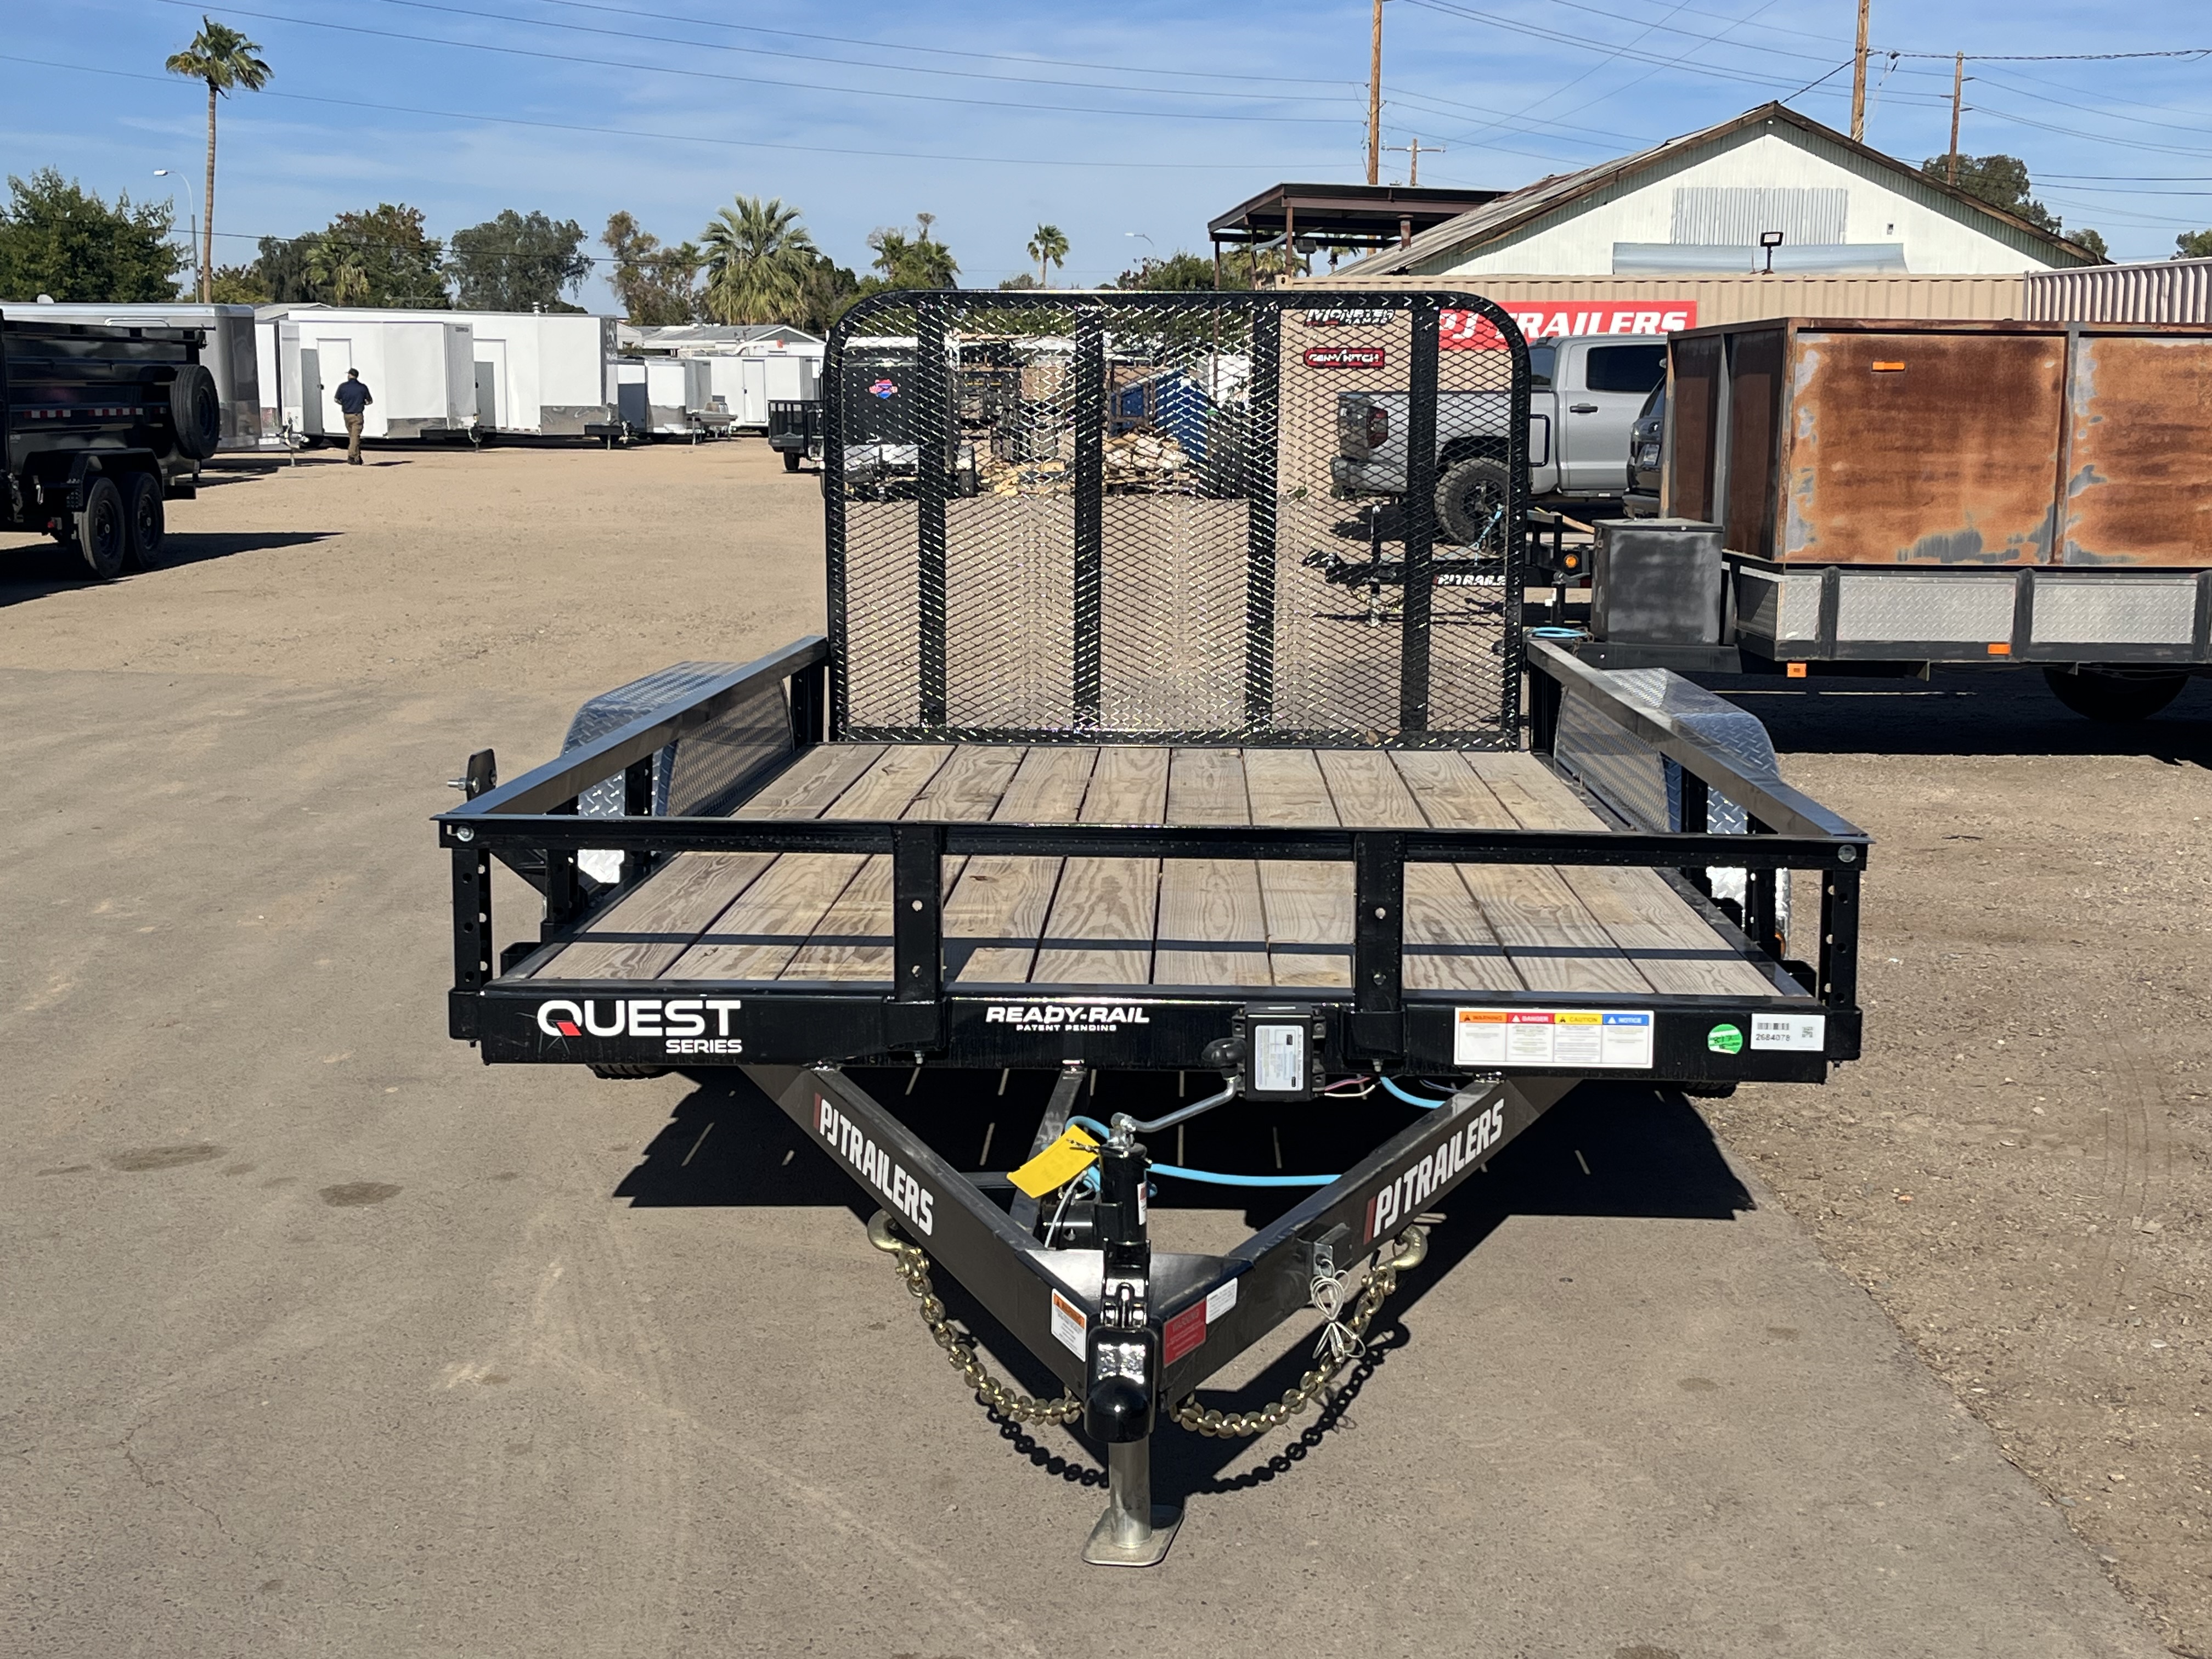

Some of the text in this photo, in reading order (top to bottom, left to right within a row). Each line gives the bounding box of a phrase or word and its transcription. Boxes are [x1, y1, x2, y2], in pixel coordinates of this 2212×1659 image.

[537, 1000, 741, 1036] QUEST
[986, 1006, 1150, 1024] READY-RAIL
[665, 1040, 742, 1053] SERIES
